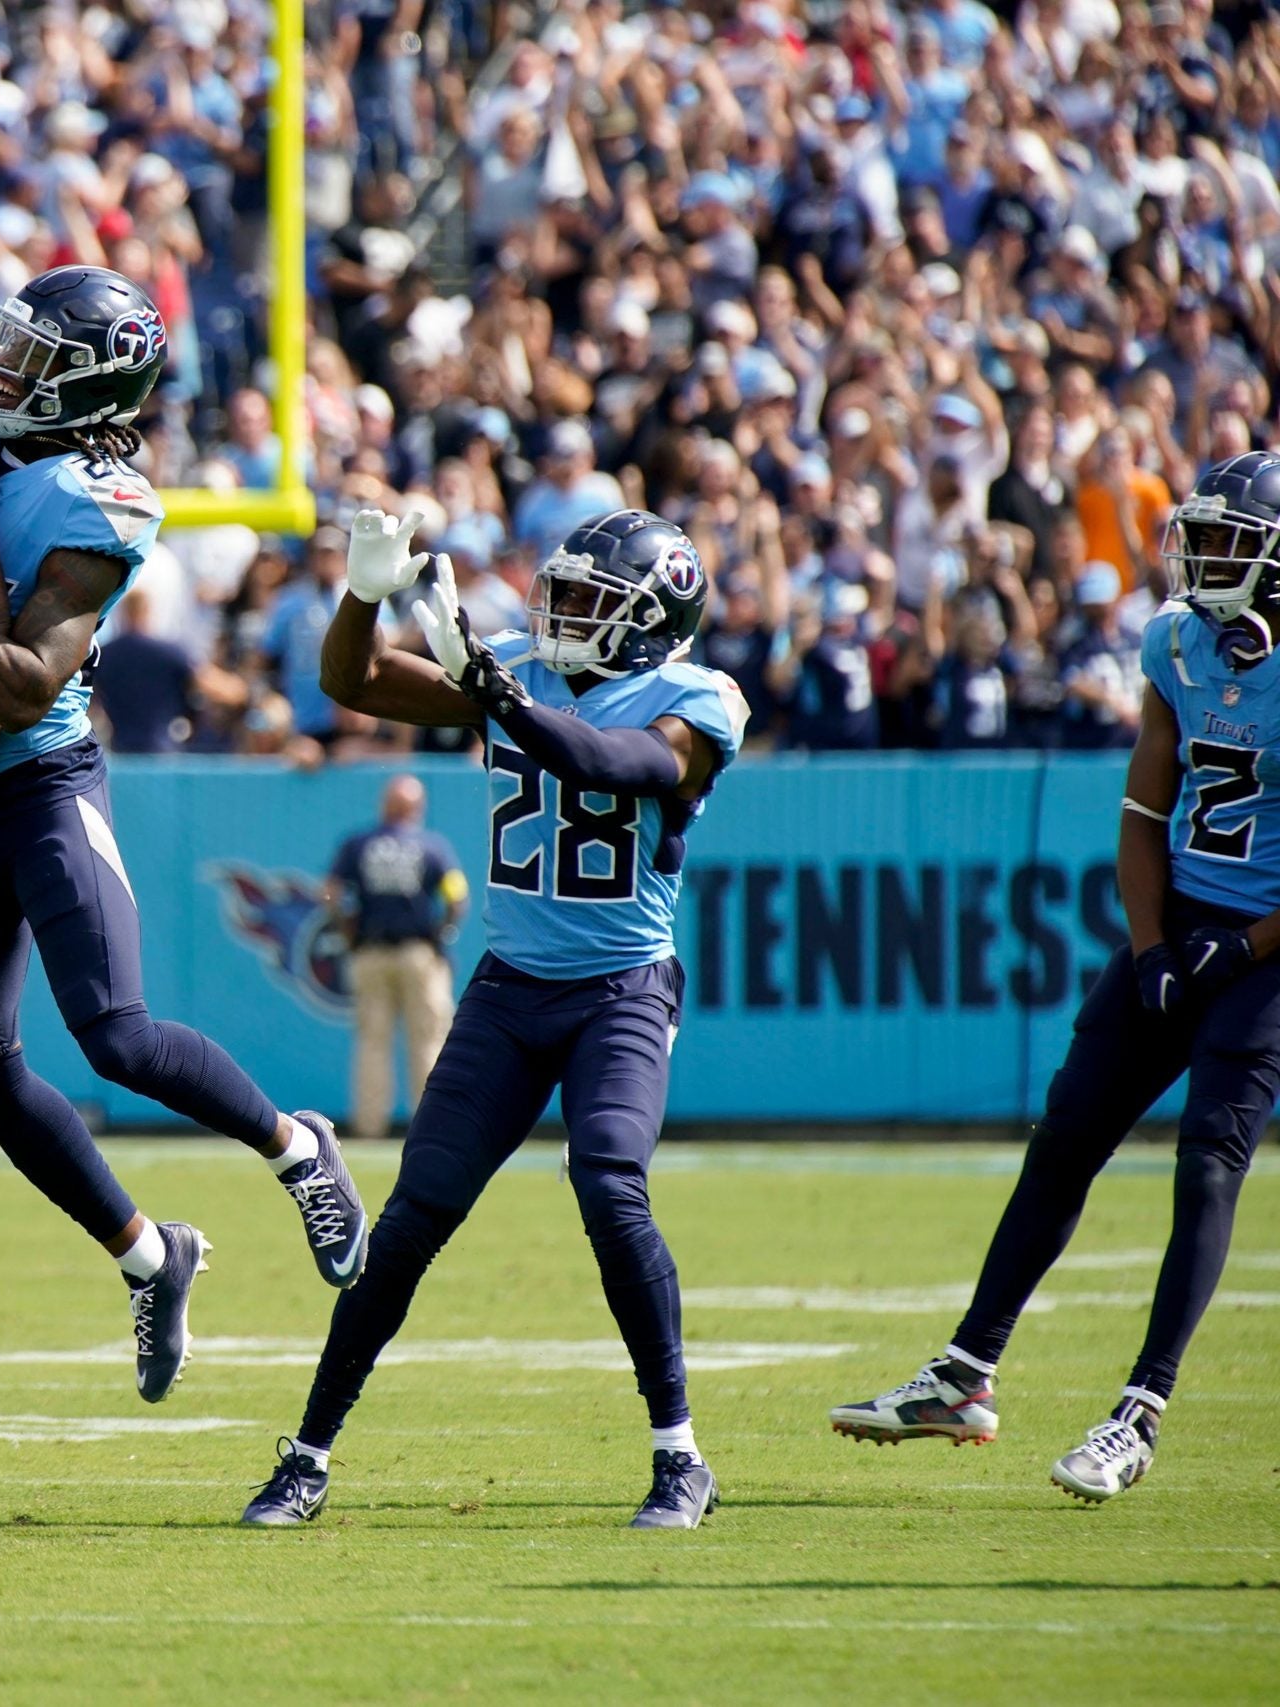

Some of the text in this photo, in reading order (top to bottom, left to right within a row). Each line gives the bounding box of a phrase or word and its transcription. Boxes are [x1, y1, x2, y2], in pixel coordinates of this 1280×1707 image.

[1204, 710, 1258, 745] TITANS
[488, 742, 642, 903] 28
[1185, 737, 1264, 862] 2
